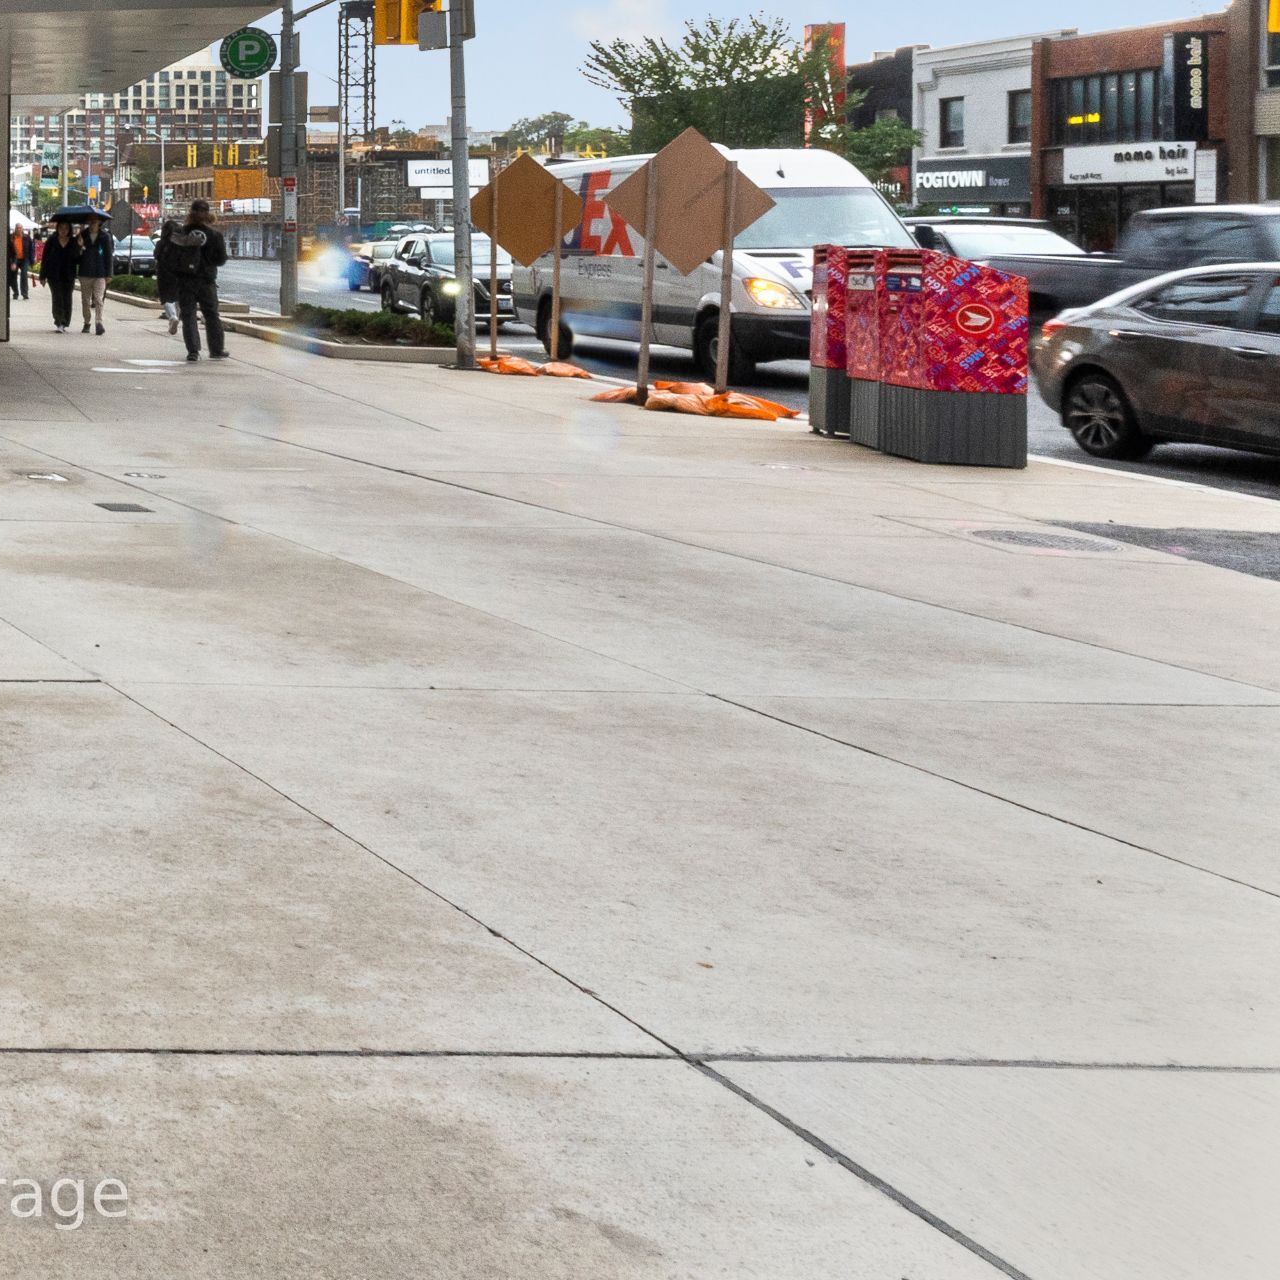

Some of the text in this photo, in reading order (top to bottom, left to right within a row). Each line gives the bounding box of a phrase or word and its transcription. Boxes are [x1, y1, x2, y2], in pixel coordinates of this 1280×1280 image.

[238, 40, 261, 61] P
[916, 170, 985, 189] FOGTOWN
[578, 257, 614, 279] Express
[936, 259, 966, 283] P9A
[924, 276, 949, 295] H9X
